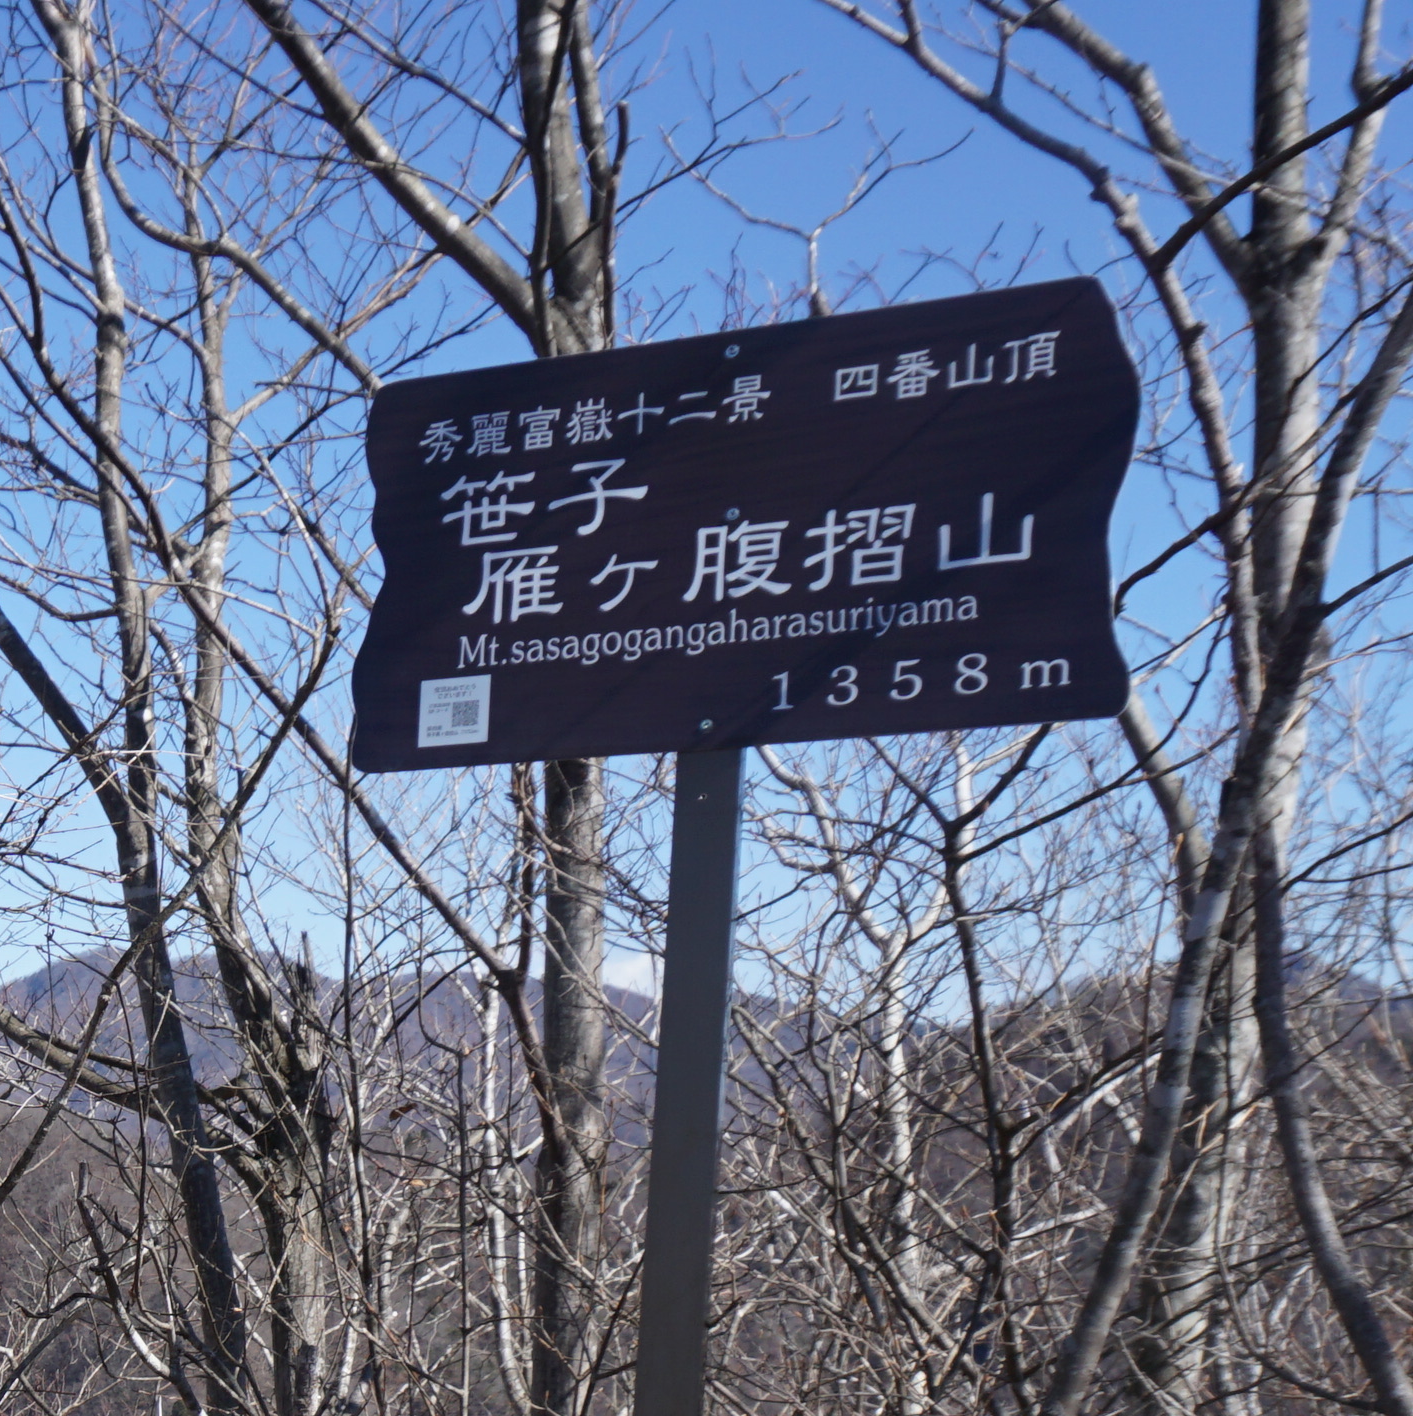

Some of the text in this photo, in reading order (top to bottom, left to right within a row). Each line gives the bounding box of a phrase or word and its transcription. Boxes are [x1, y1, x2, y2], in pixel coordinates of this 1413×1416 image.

[419, 330, 1062, 465] 秀麗富嶽十二景 四番山頂
[440, 458, 650, 546] 笹子
[457, 594, 979, 669] Mt.sasagogangaharasuriyama
[1019, 657, 1072, 690] m
